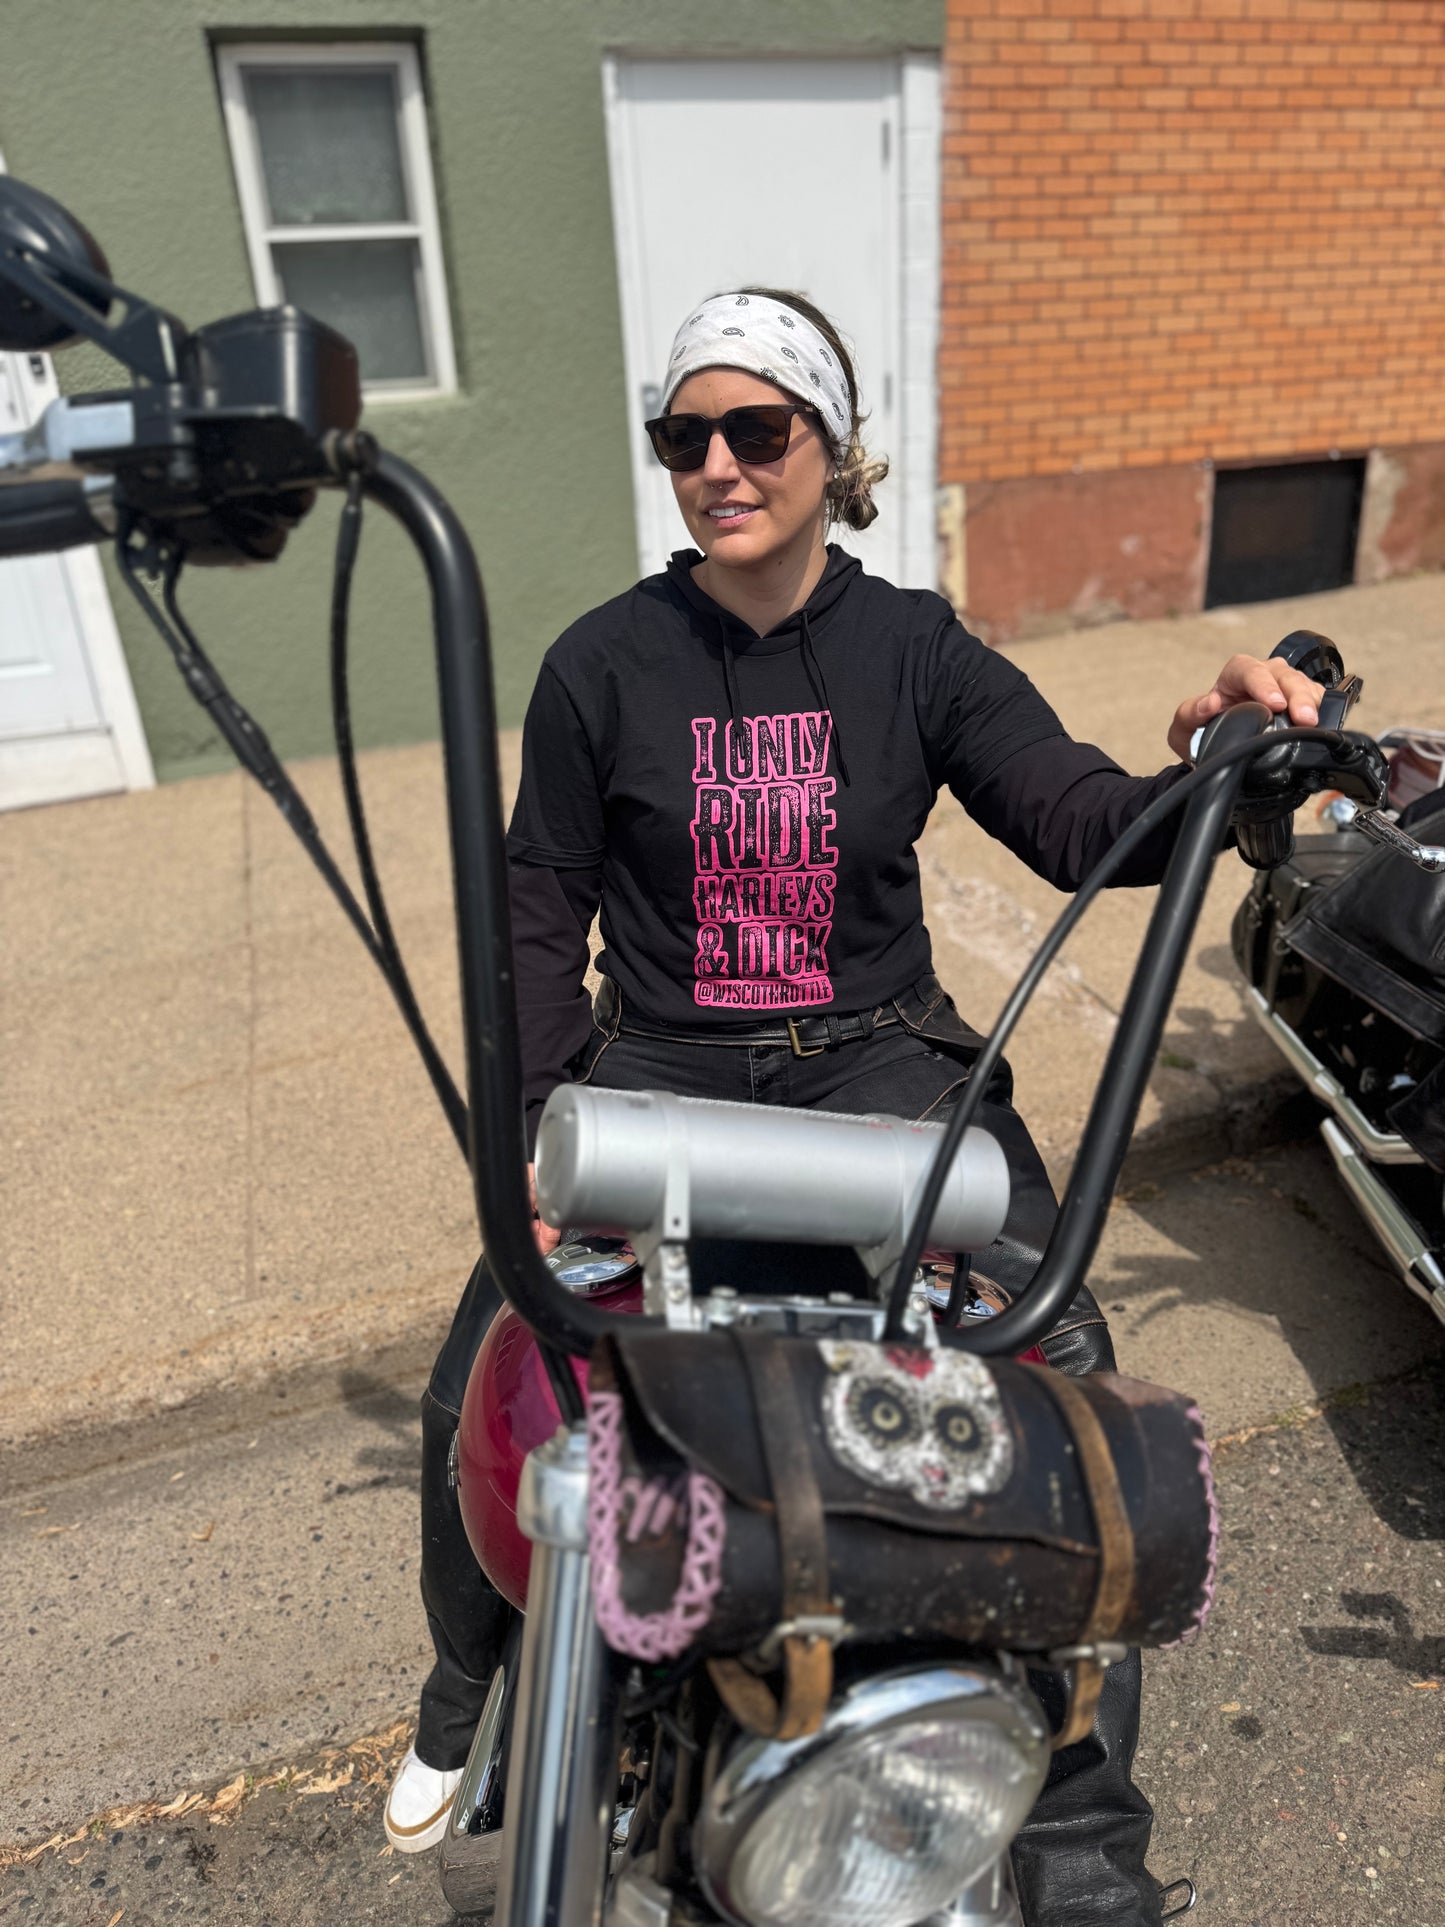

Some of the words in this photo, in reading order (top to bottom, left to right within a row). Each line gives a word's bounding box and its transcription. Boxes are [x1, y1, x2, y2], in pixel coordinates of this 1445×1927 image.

[693, 719, 714, 781] I
[727, 712, 831, 780] ONLY
[692, 779, 837, 872] RIDE
[694, 872, 835, 921] HARLEYS
[696, 925, 727, 978] &
[740, 922, 830, 979] DICK
[696, 977, 832, 1007] @WISCOTHROTTLE
